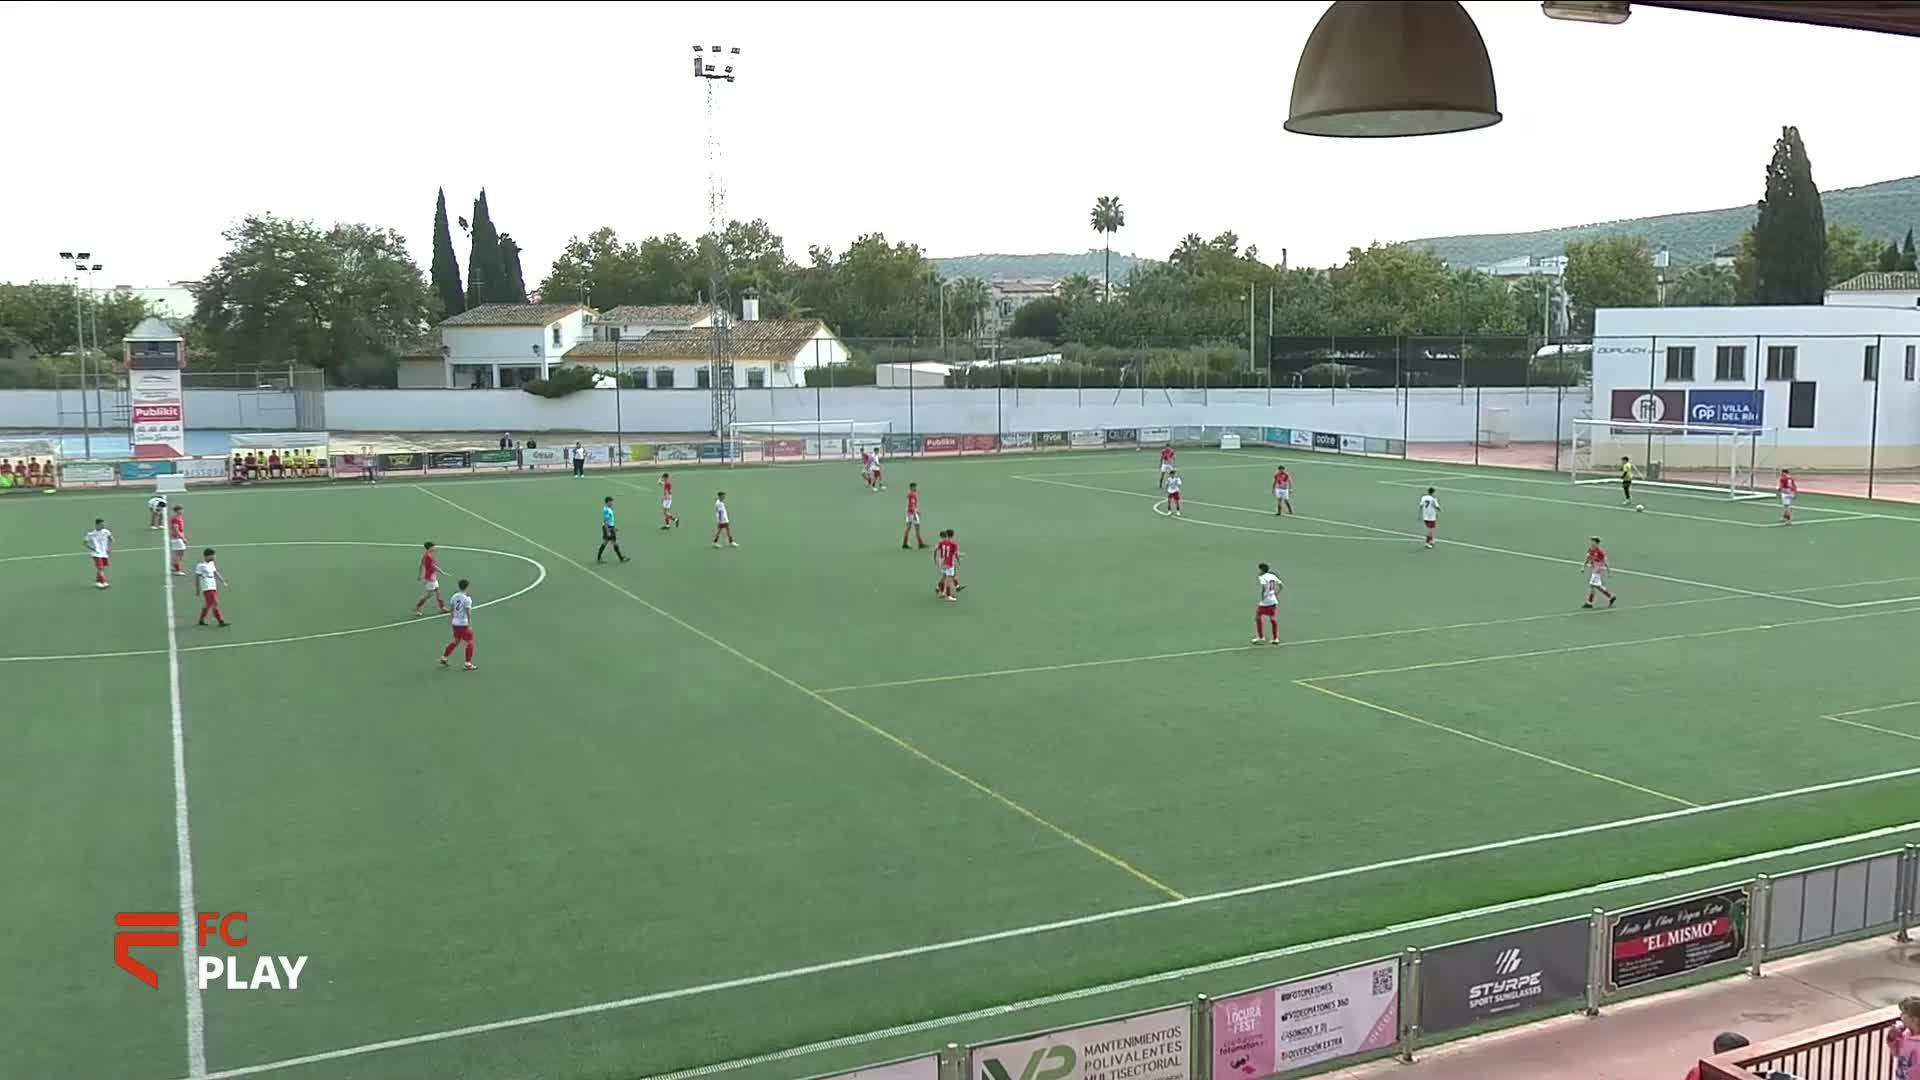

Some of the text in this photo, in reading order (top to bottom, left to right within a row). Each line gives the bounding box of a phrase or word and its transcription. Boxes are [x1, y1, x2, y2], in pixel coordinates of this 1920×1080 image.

[135, 407, 178, 416] Publikit
[1722, 412, 1739, 421] DEL
[927, 437, 956, 446] Publikit
[1469, 970, 1544, 999] STYRPE
[1469, 995, 1494, 1009] SPORT
[1494, 986, 1542, 1003] SUNGLASSES
[1226, 1004, 1262, 1025] LOCURA
[1233, 1018, 1257, 1033] FEST
[1084, 1026, 1182, 1057] MANTENIMIENTOS
[1323, 1036, 1343, 1050] EXTRA
[1084, 1041, 1182, 1072] POLIVALENTES
[1083, 1056, 1181, 1080] MULTISECTORIAL
